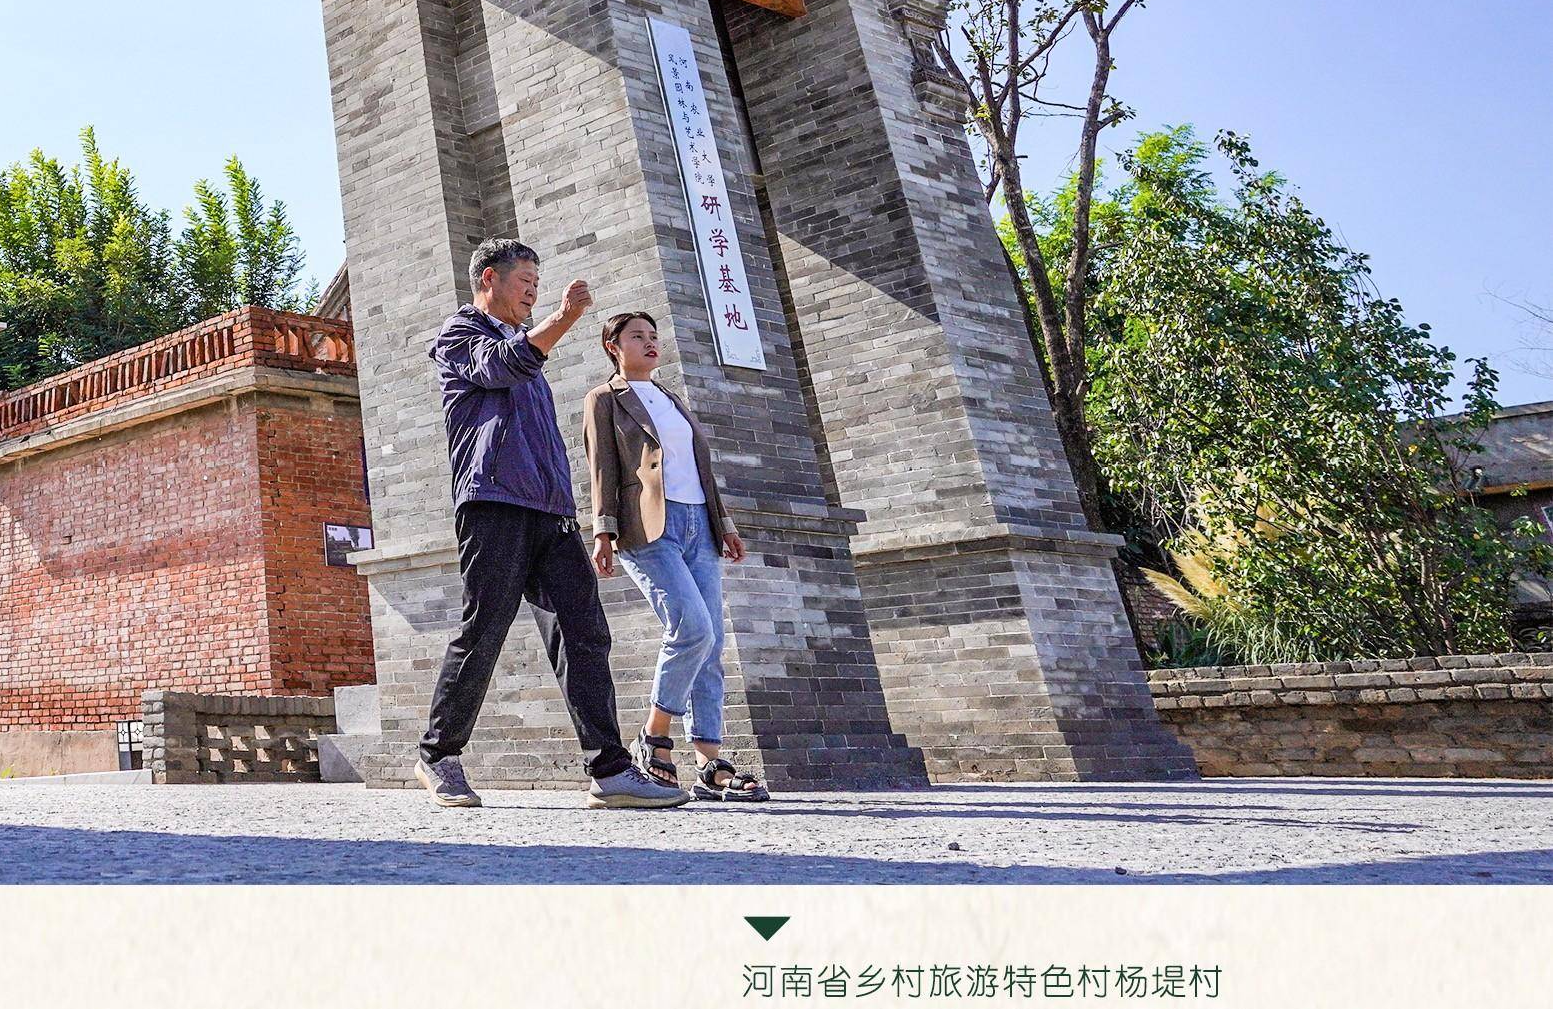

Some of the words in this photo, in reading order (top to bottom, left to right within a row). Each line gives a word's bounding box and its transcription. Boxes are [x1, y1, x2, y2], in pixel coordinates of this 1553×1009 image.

[667, 53, 705, 185] 风景园林与艺术学院
[678, 56, 716, 187] 河南农业大学
[700, 194, 749, 331] 研学基地
